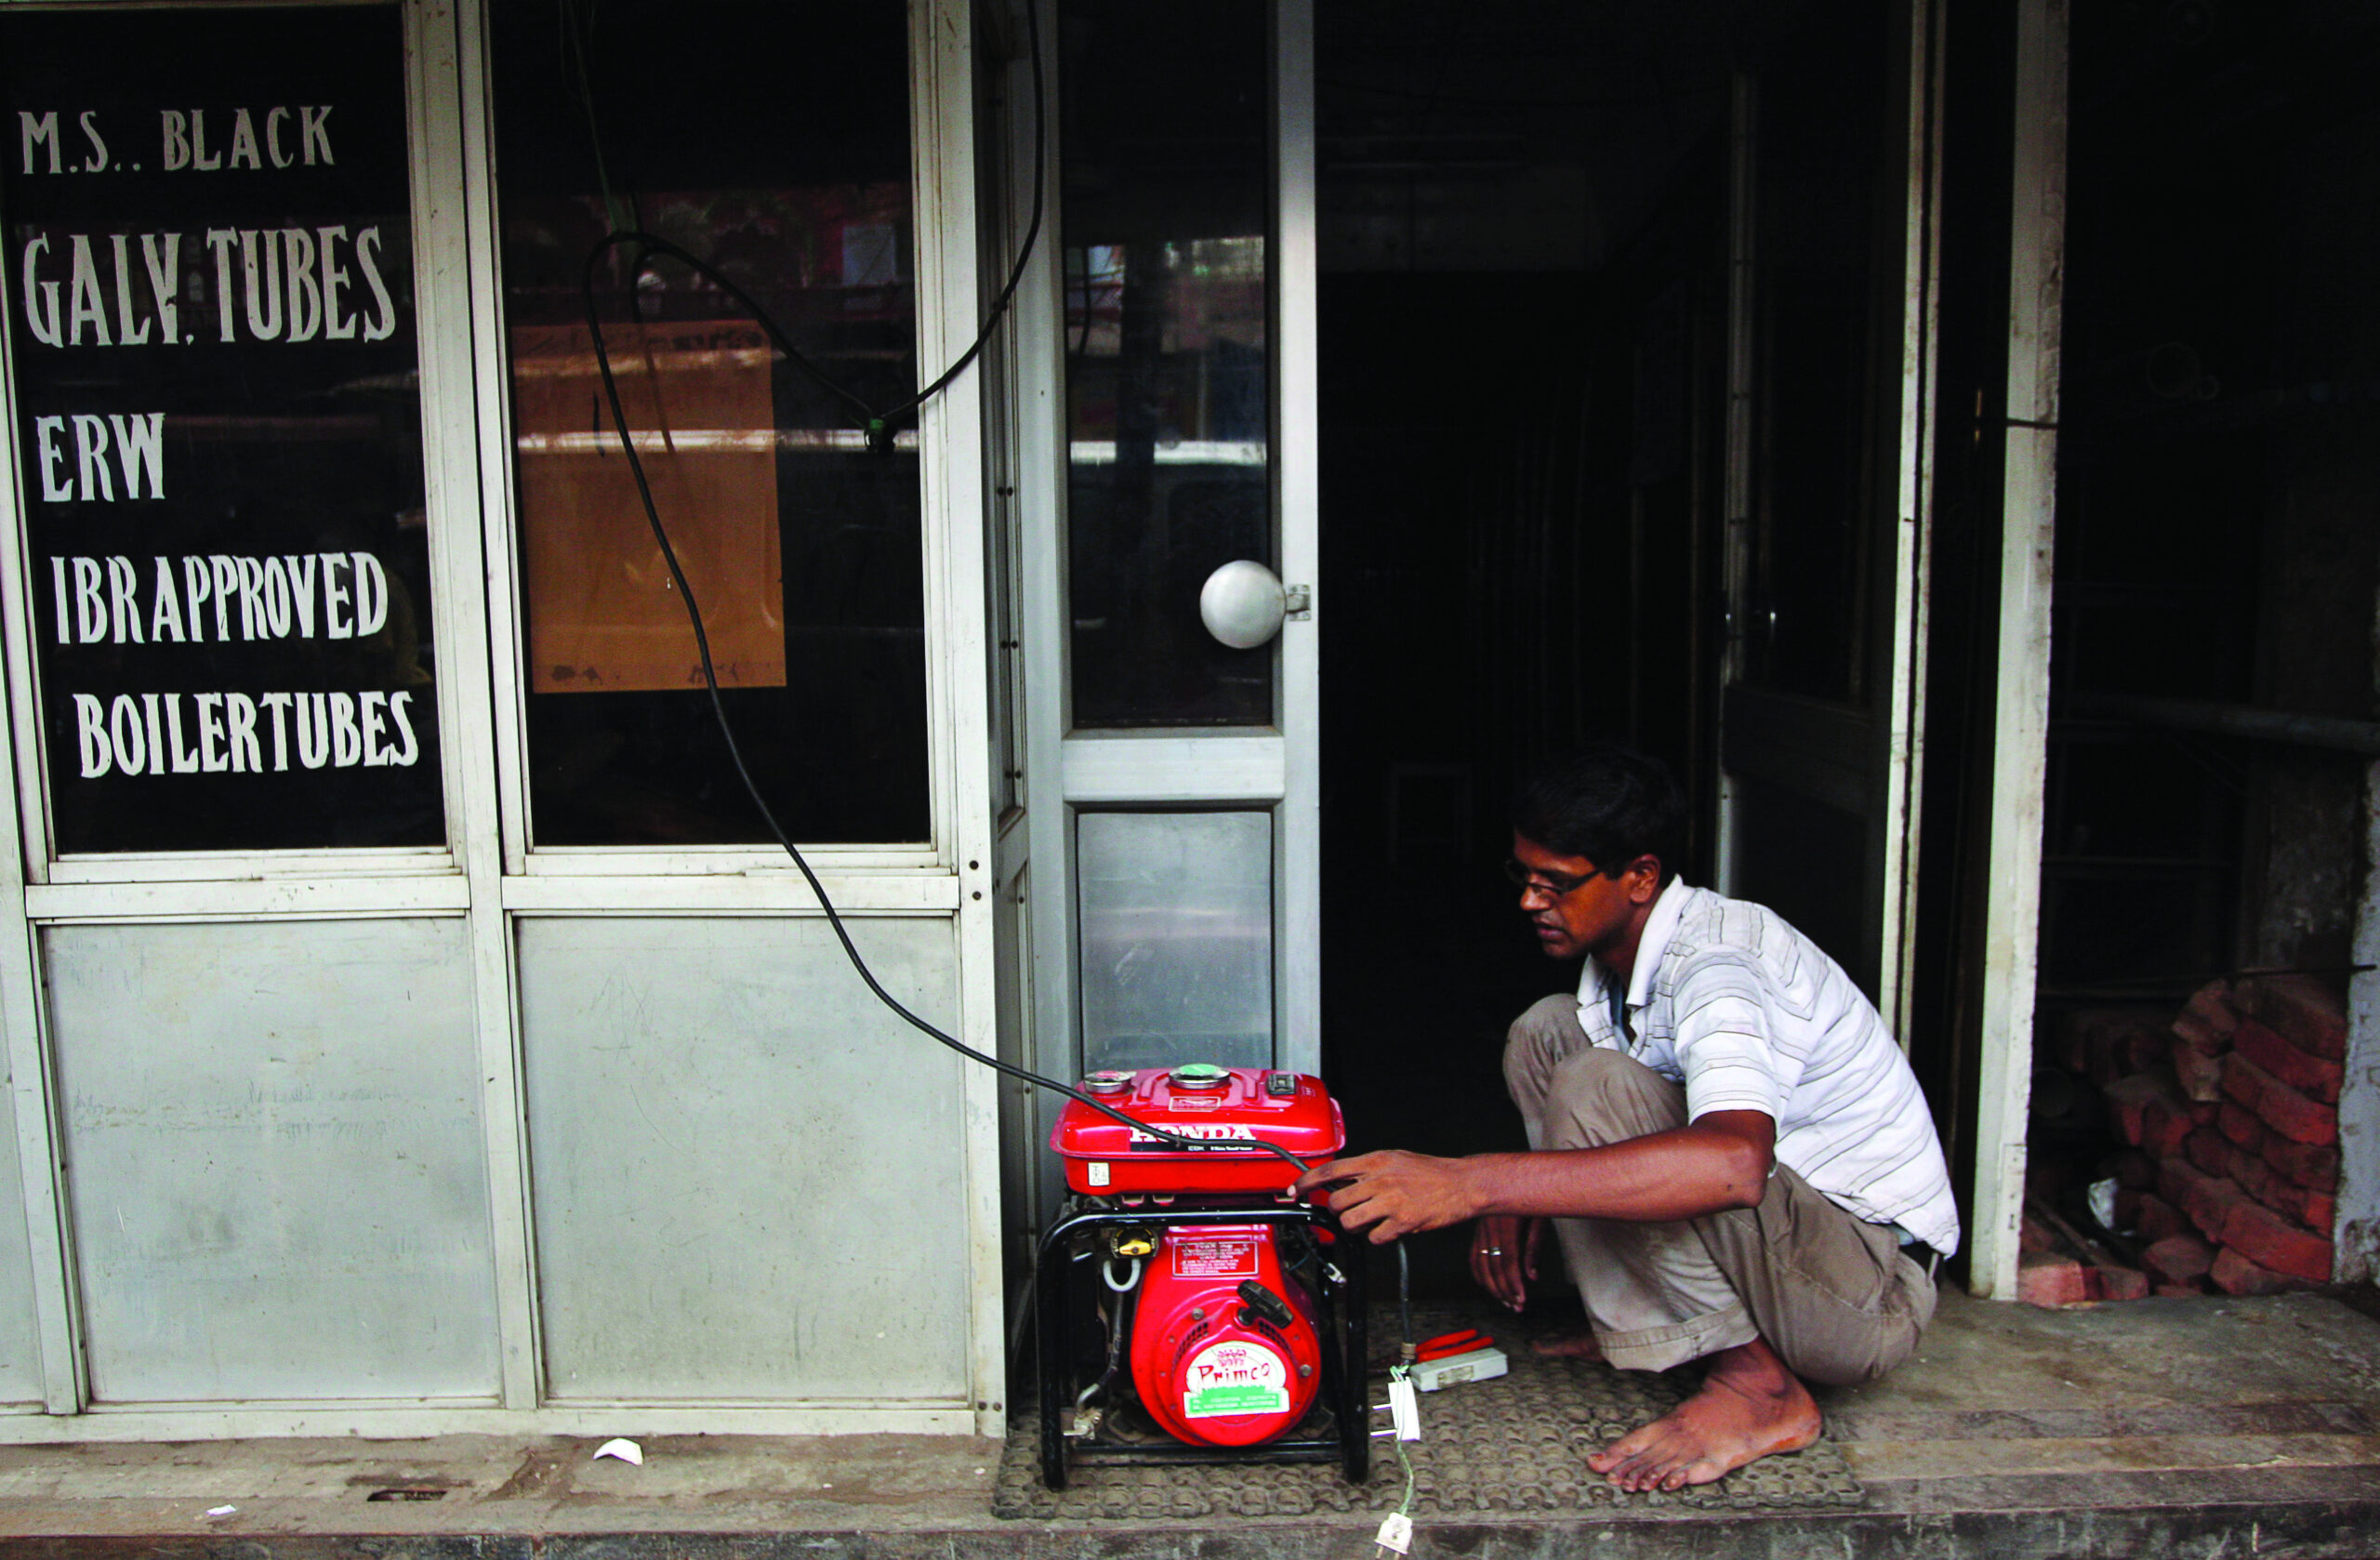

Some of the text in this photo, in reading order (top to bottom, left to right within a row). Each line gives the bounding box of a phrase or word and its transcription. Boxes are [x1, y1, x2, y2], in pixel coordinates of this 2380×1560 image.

[161, 106, 335, 171] BLACK
[22, 225, 397, 349] GALV. TUBES
[35, 412, 165, 503] ERW
[50, 551, 389, 644] IBR APPROVED
[1197, 1362, 1271, 1383] Primco
